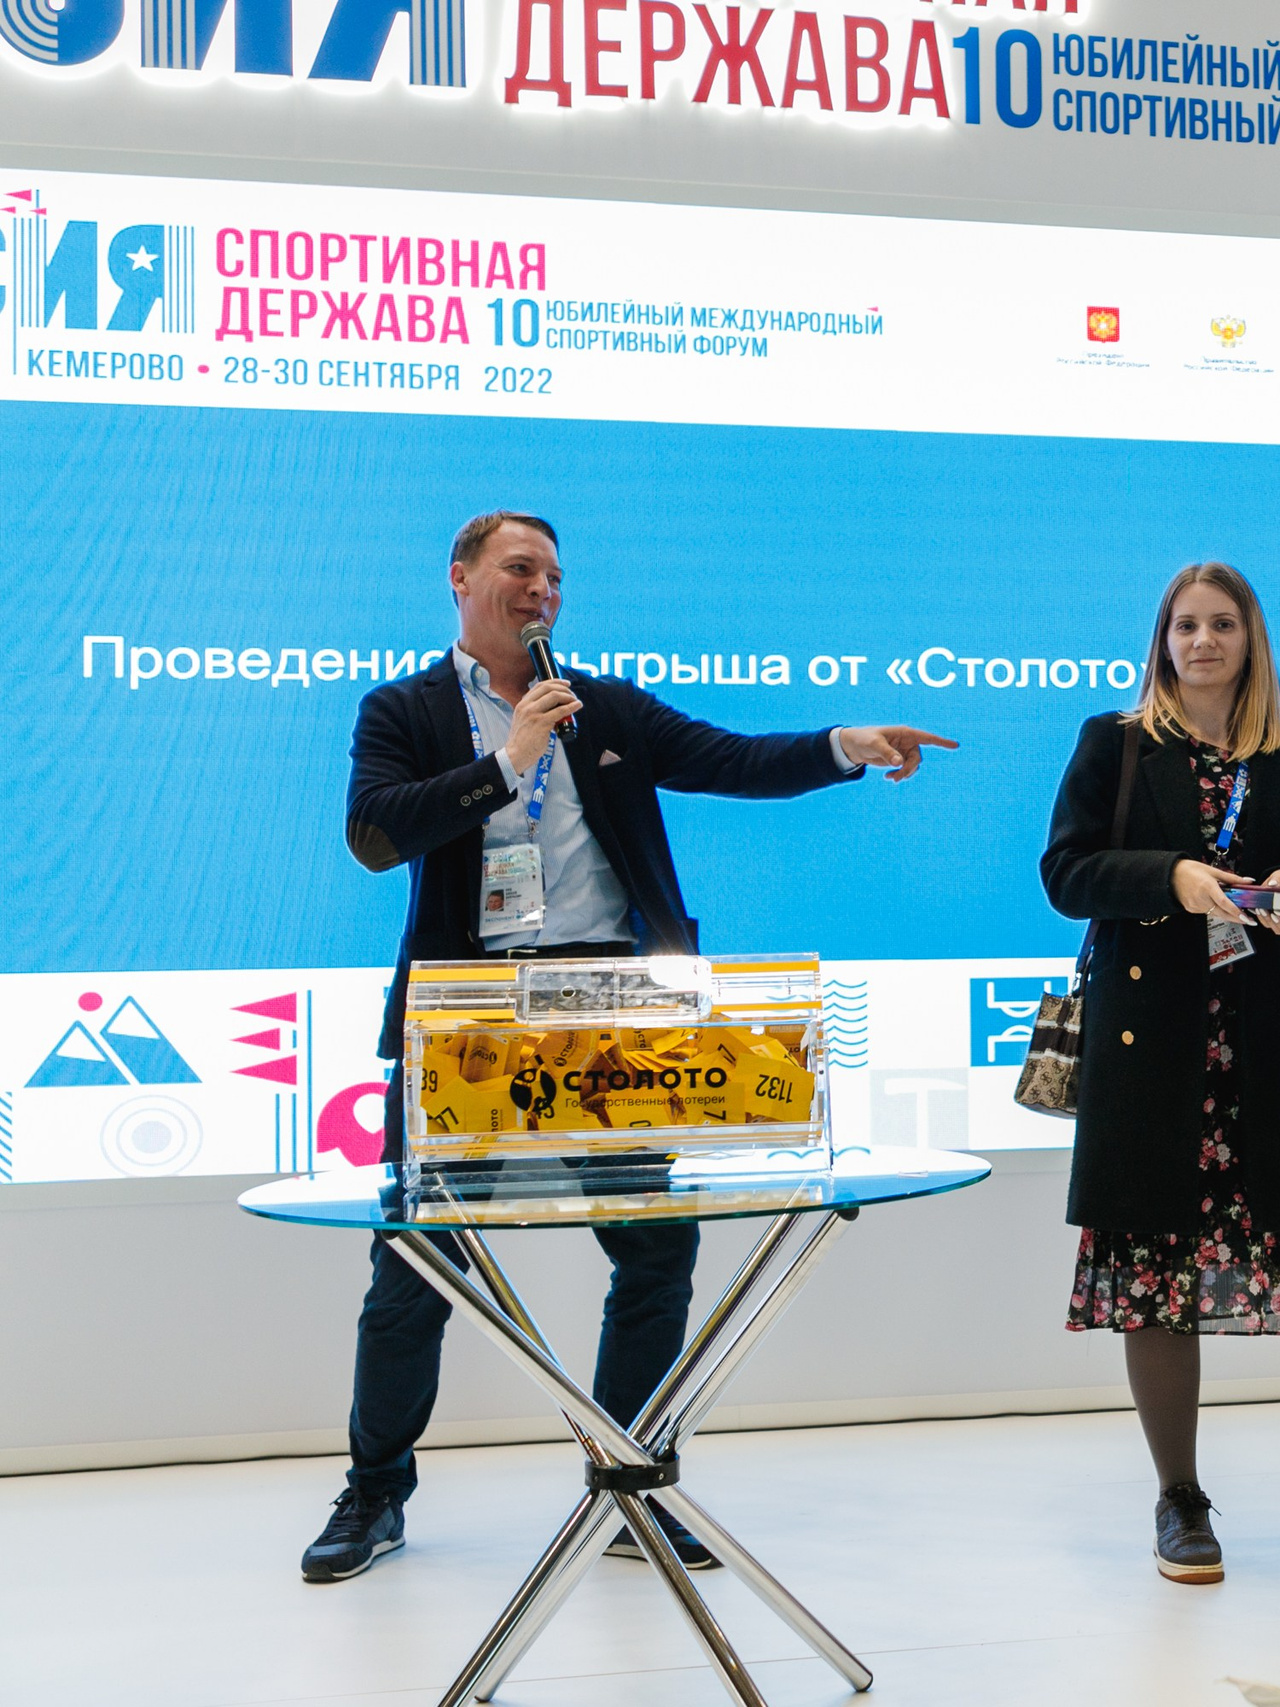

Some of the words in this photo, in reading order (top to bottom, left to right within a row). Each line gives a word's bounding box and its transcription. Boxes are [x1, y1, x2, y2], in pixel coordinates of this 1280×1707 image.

[504, 0, 950, 119] ДЕРЖАВА
[952, 26, 1042, 128] 10
[0, 217, 195, 334] ИЯ
[215, 227, 546, 291] СПОРТИВНАЯ
[215, 286, 470, 345] ДЕРЖАВА
[487, 298, 540, 348] 10
[546, 299, 684, 328] ЮБИЛЕЙНЫЙ
[690, 306, 883, 335] МЕЖДУНАРОДНЫЙ
[546, 328, 687, 354] СПОРТИВНЫЙ
[692, 334, 768, 358] ФОРУМ
[28, 349, 183, 381] КЕМЕРОВО
[223, 356, 308, 386] 28-30
[318, 360, 460, 391] СЕНТЯБРЯ
[484, 366, 553, 394] 2022
[553, 651, 790, 689] ыгрыша
[807, 654, 868, 687] от
[563, 1067, 728, 1092] СТОЛОТО
[755, 1073, 793, 1103] 1132
[565, 1098, 672, 1109] Государственные
